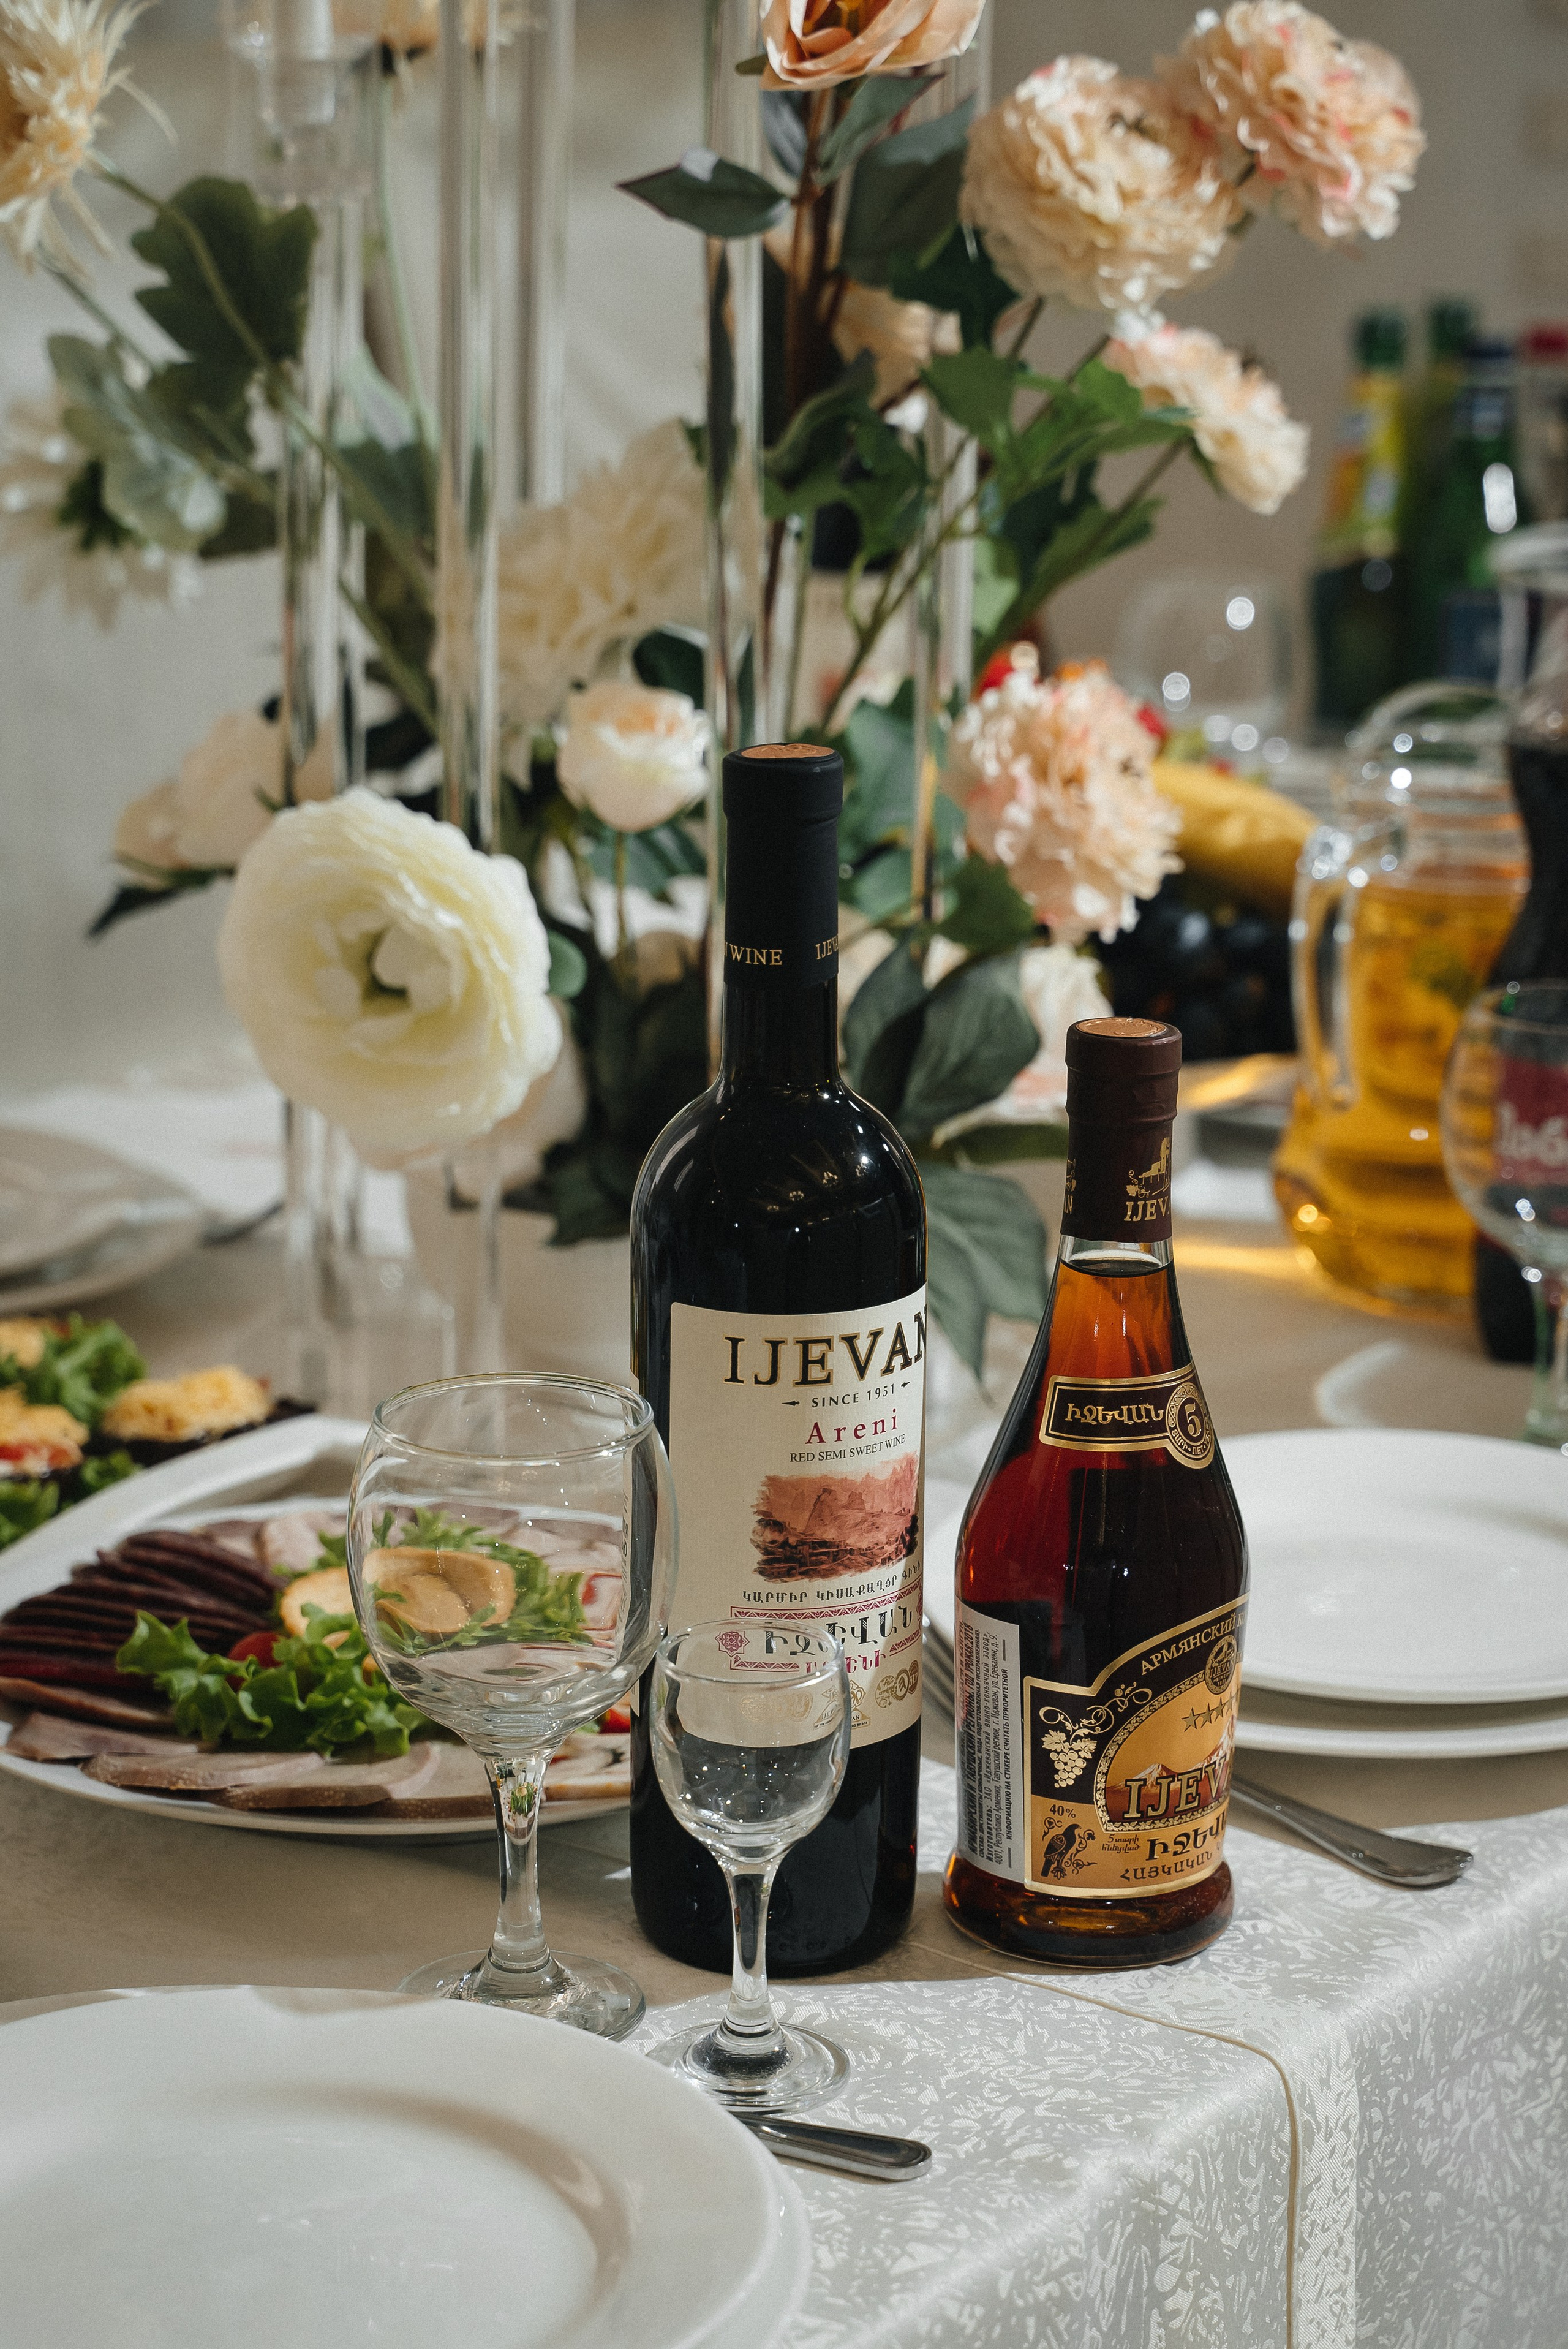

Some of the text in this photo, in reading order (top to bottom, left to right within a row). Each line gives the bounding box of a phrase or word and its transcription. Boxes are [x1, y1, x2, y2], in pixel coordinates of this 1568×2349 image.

[730, 944, 782, 966] WINE
[1124, 1195, 1170, 1222] IJEV
[723, 1305, 926, 1388] IJEVAN
[812, 1383, 895, 1408] SINCE 1951
[804, 1408, 898, 1445] Areni
[1065, 1402, 1164, 1425] ԻՋԵՎԱՆ
[1185, 1402, 1202, 1437] 5
[790, 1434, 906, 1462] RED SEMI SWEET WINE
[1192, 1444, 1204, 1455] ЛЕТ
[742, 1591, 808, 1603] ԿԱՐՄԻՐ
[1141, 1611, 1236, 1676] АРМЯНСКИЙ
[989, 1649, 1000, 1679] Ереванян,
[965, 1673, 974, 1690] ГОД
[982, 1662, 990, 1728] винно-коньячный
[992, 1680, 1001, 1690] ул.
[1001, 1668, 1009, 1721] ПРИОРИТЕТНОЙ
[965, 1690, 975, 1733] РЕГИОНЫ.
[990, 1690, 1000, 1719] Иджеван,
[993, 1728, 1003, 1751] регион,
[992, 1750, 1003, 1783] Тавушский
[984, 1786, 992, 1801] ЗАО
[993, 1785, 1004, 1814] Армения,
[1005, 1781, 1011, 1790] НА
[1122, 1753, 1227, 1820] IJEV
[1049, 1804, 1076, 1818] 40%
[985, 1804, 993, 1863] Изготовитель:
[993, 1814, 1005, 1848] Республика
[1107, 1834, 1115, 1843] 5
